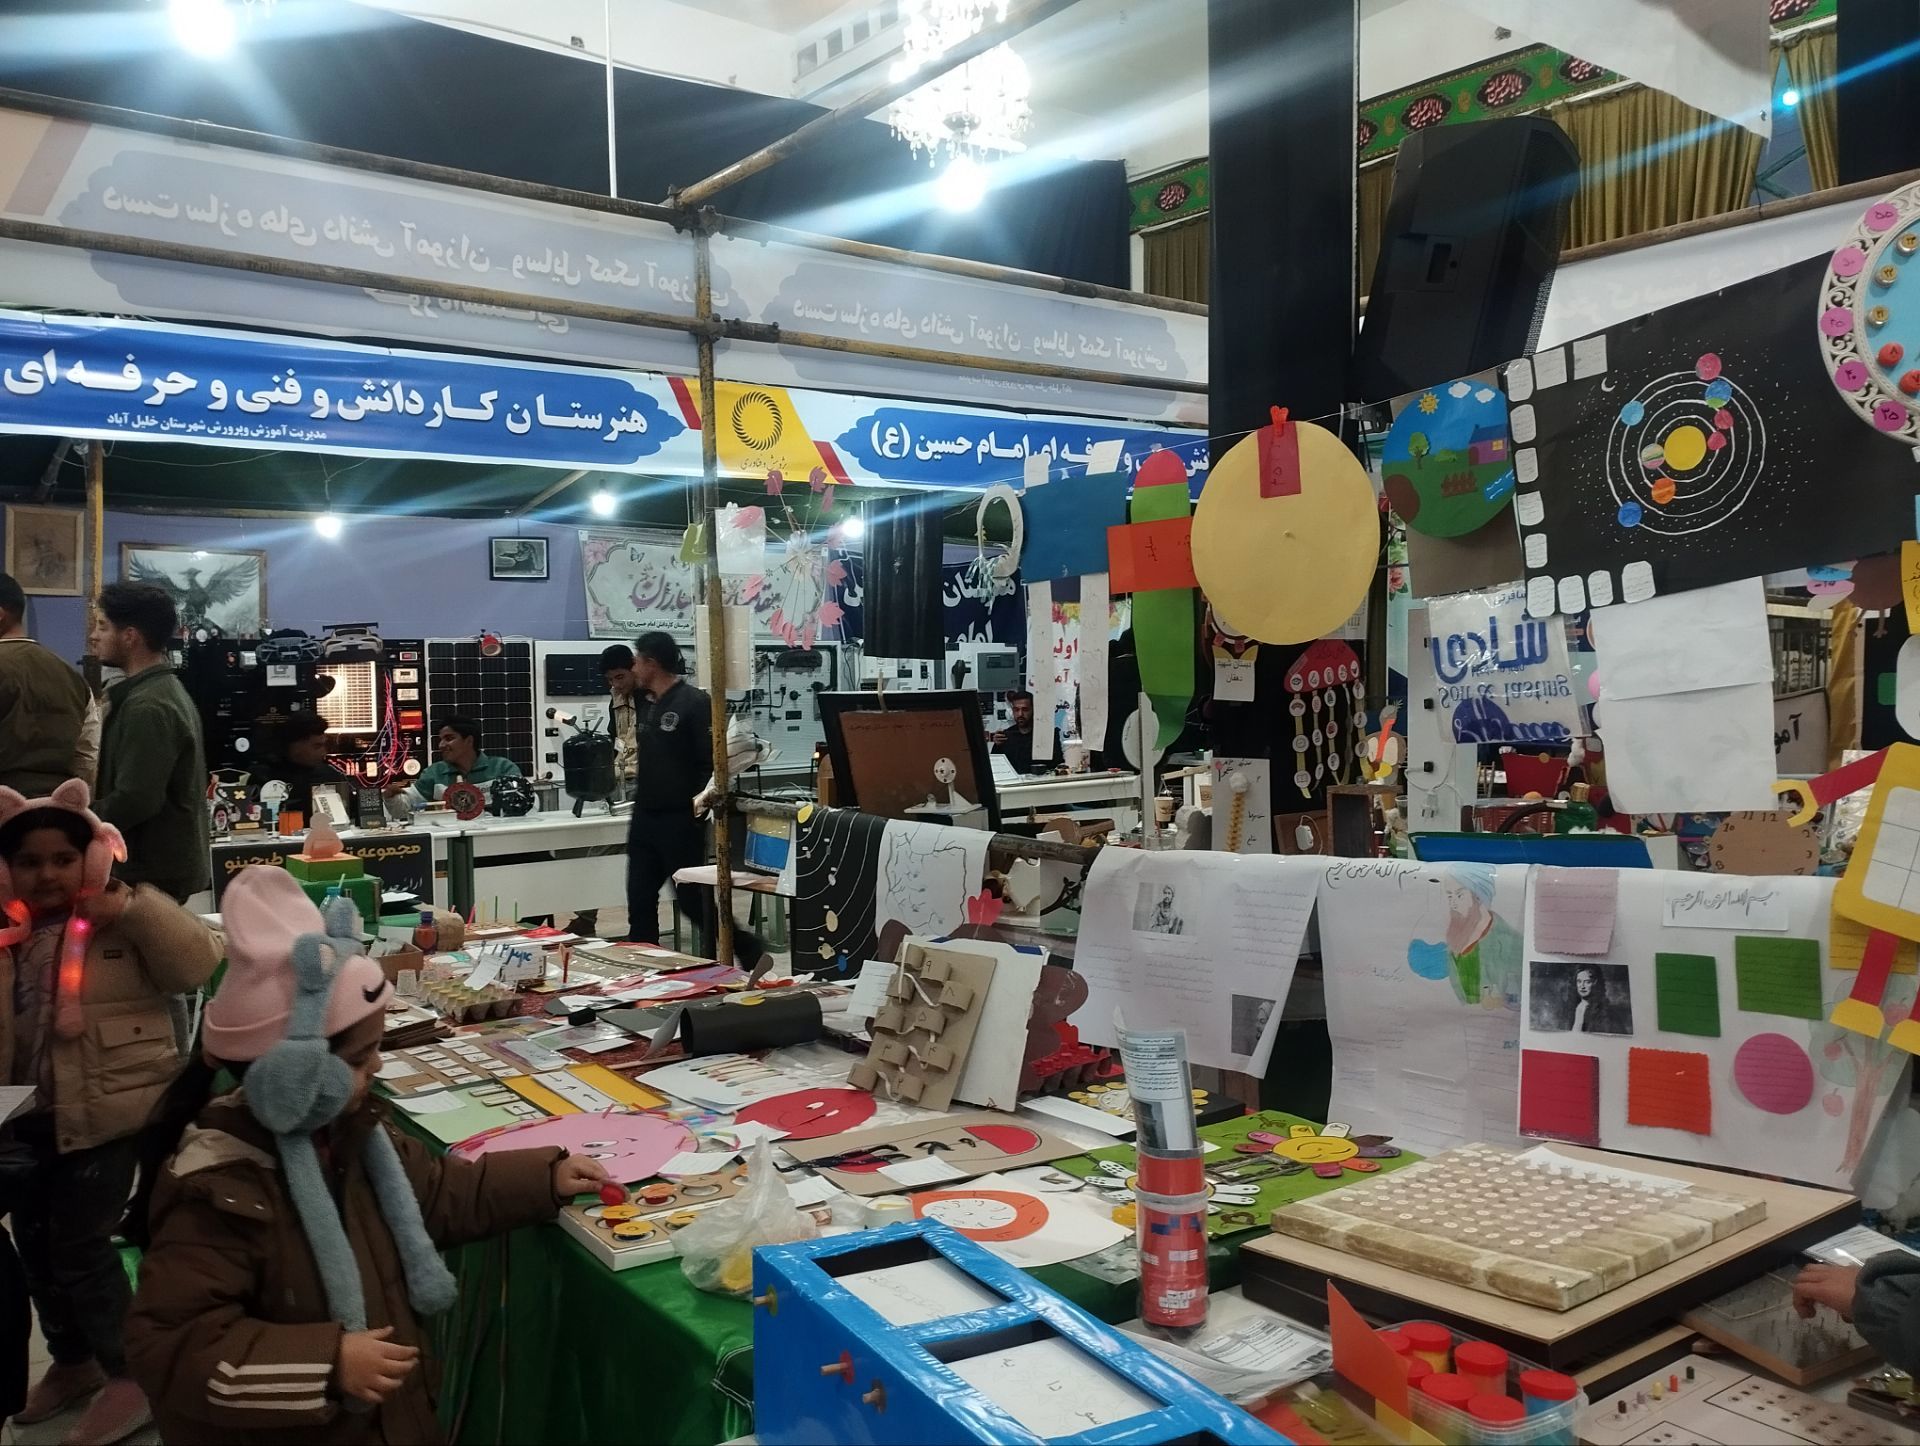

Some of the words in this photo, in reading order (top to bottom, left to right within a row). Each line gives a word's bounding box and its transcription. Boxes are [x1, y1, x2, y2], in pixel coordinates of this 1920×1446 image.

[207, 379, 228, 410] و
[236, 368, 302, 413] فنی
[310, 388, 330, 419] و
[1881, 407, 1900, 421] ۳۵
[107, 412, 130, 425] آباد
[131, 413, 159, 428] خلیل
[160, 416, 205, 432] شهرستان
[506, 393, 648, 442] هنرستان
[250, 424, 288, 439] آموزش
[289, 427, 327, 441] مدیریت
[871, 420, 911, 459] (ع)
[915, 434, 973, 461] حسین
[976, 431, 1030, 465] امام
[357, 843, 422, 861] مجموعه
[1398, 866, 1421, 889] بسم
